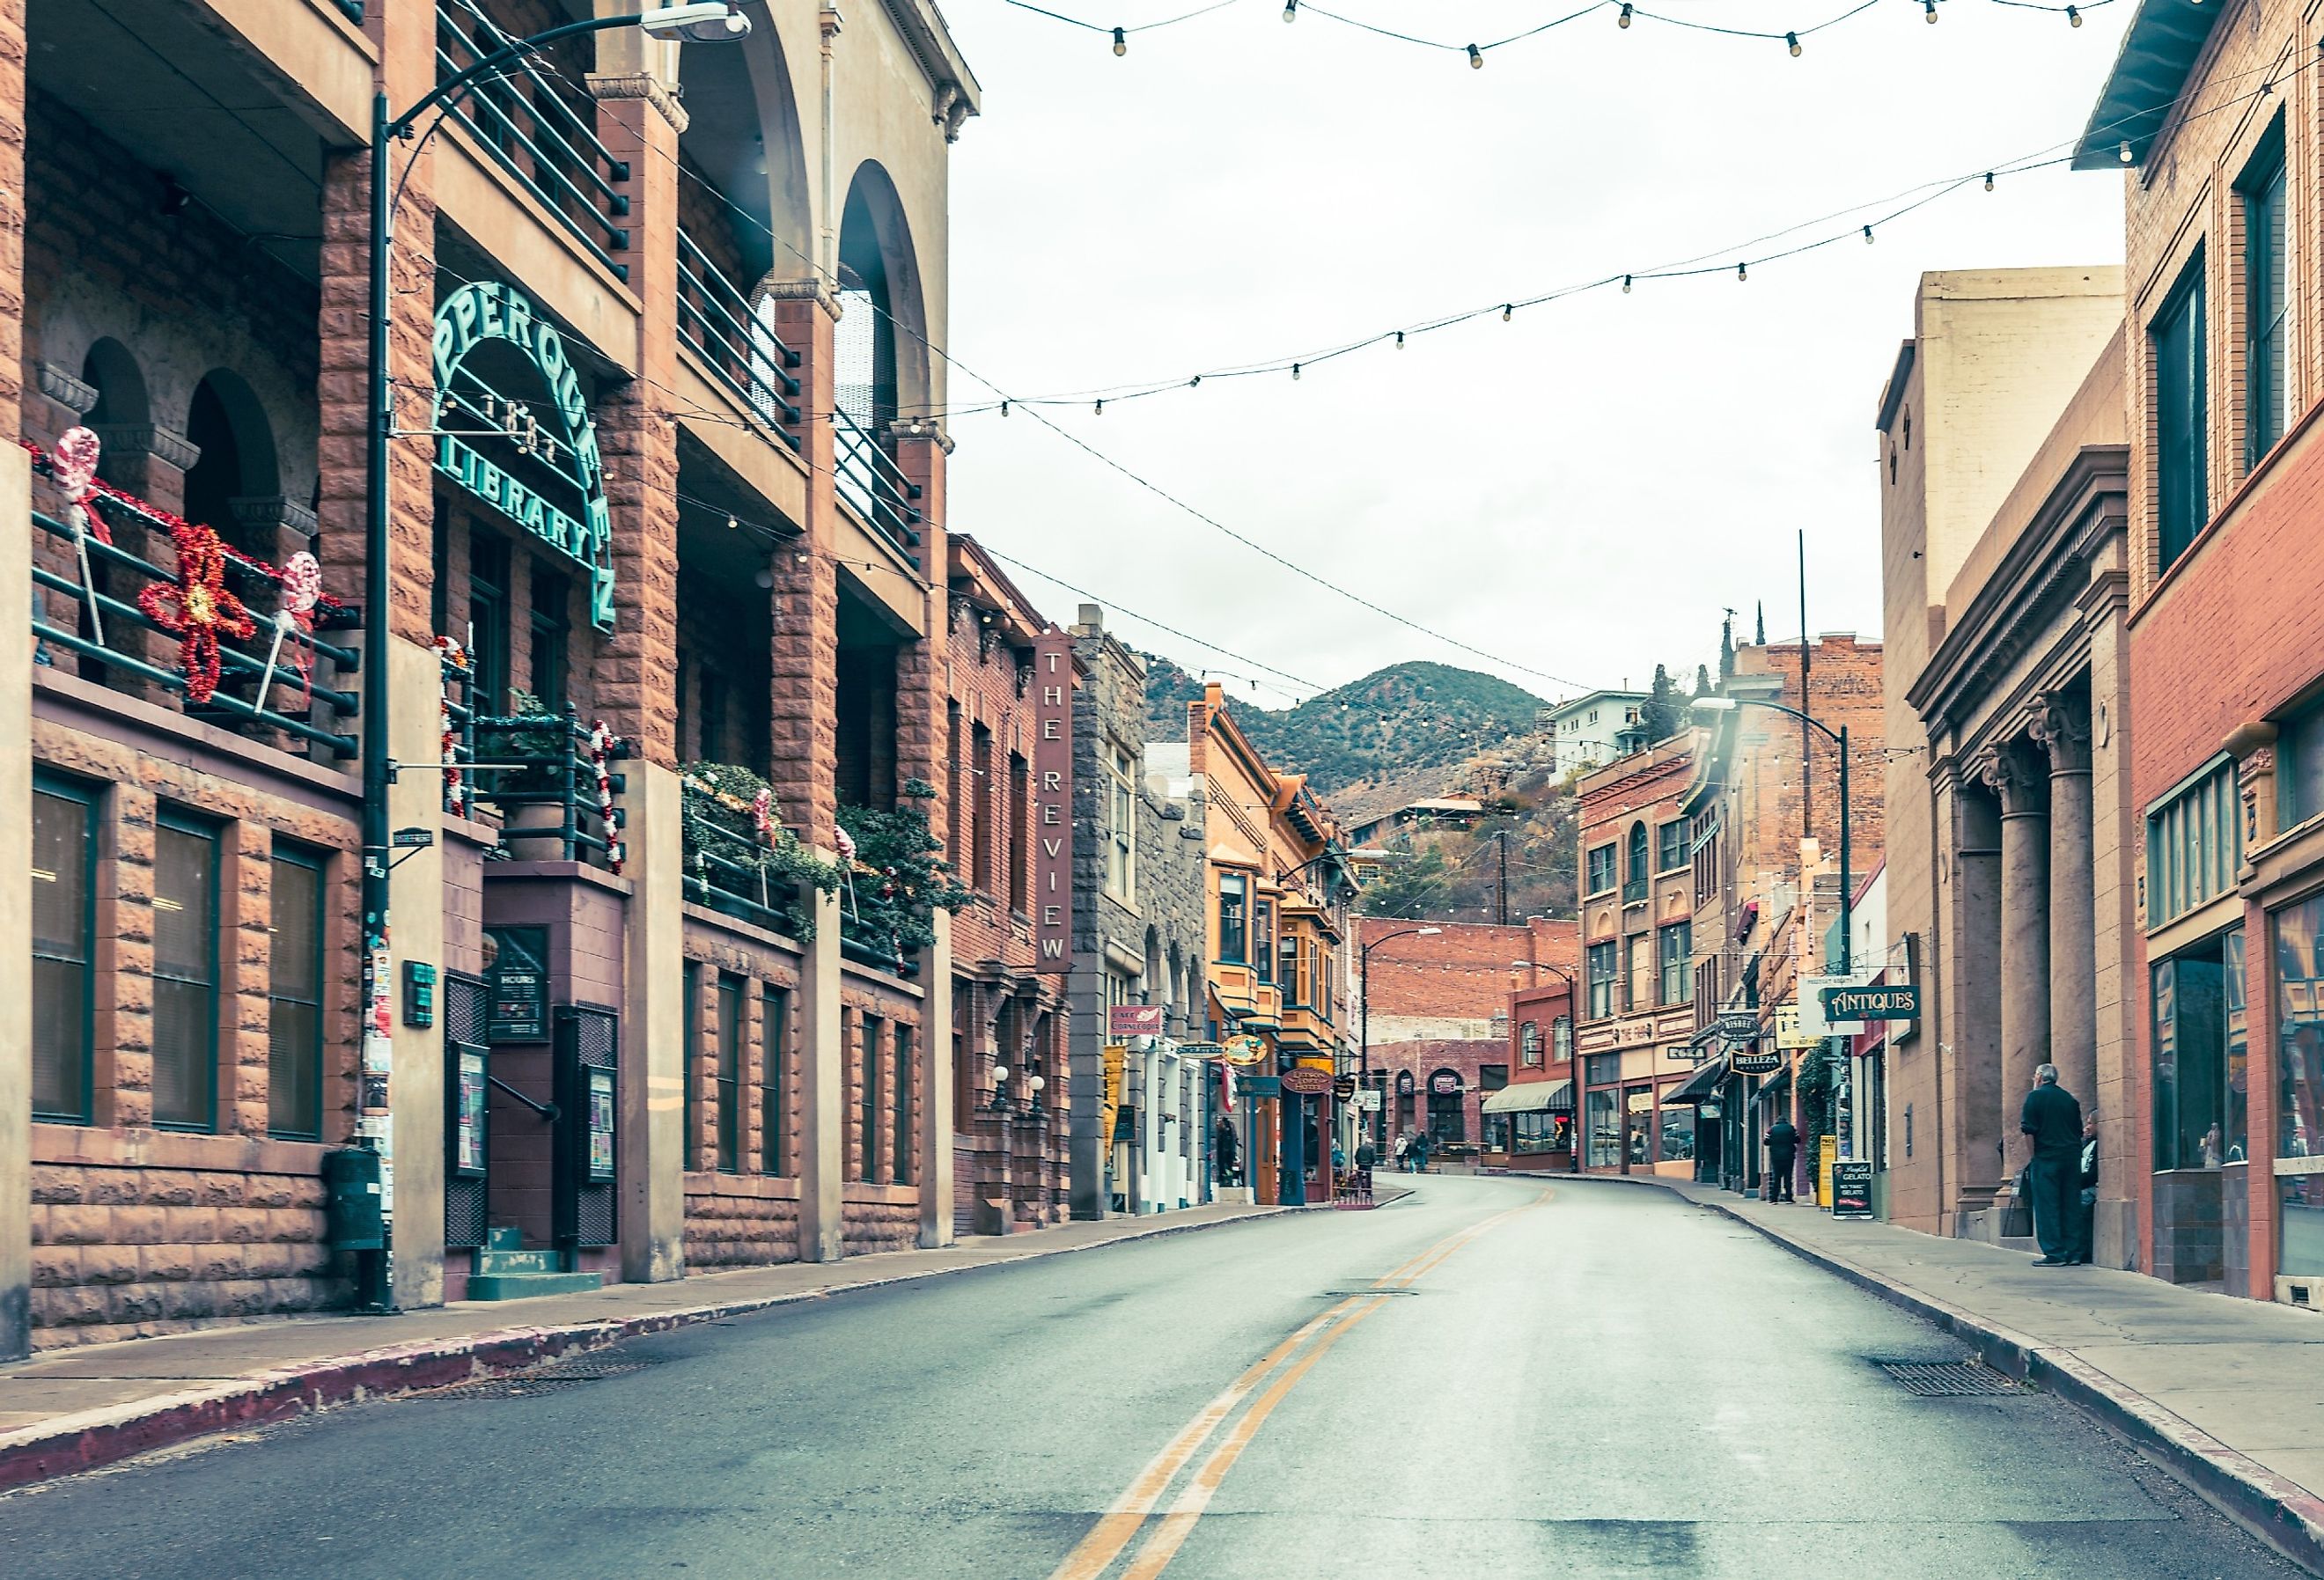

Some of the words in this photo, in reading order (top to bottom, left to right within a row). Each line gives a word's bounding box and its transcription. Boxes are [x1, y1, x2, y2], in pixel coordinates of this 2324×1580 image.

[441, 435, 588, 557] LIBRARY
[538, 322, 616, 624] QUEEN
[1043, 652, 1063, 740] THE
[1041, 771, 1064, 959] REVIEW
[501, 975, 536, 984] HOURS
[1831, 992, 1916, 1016] ANTIQUES
[1736, 1055, 1779, 1065] BELLEZA
